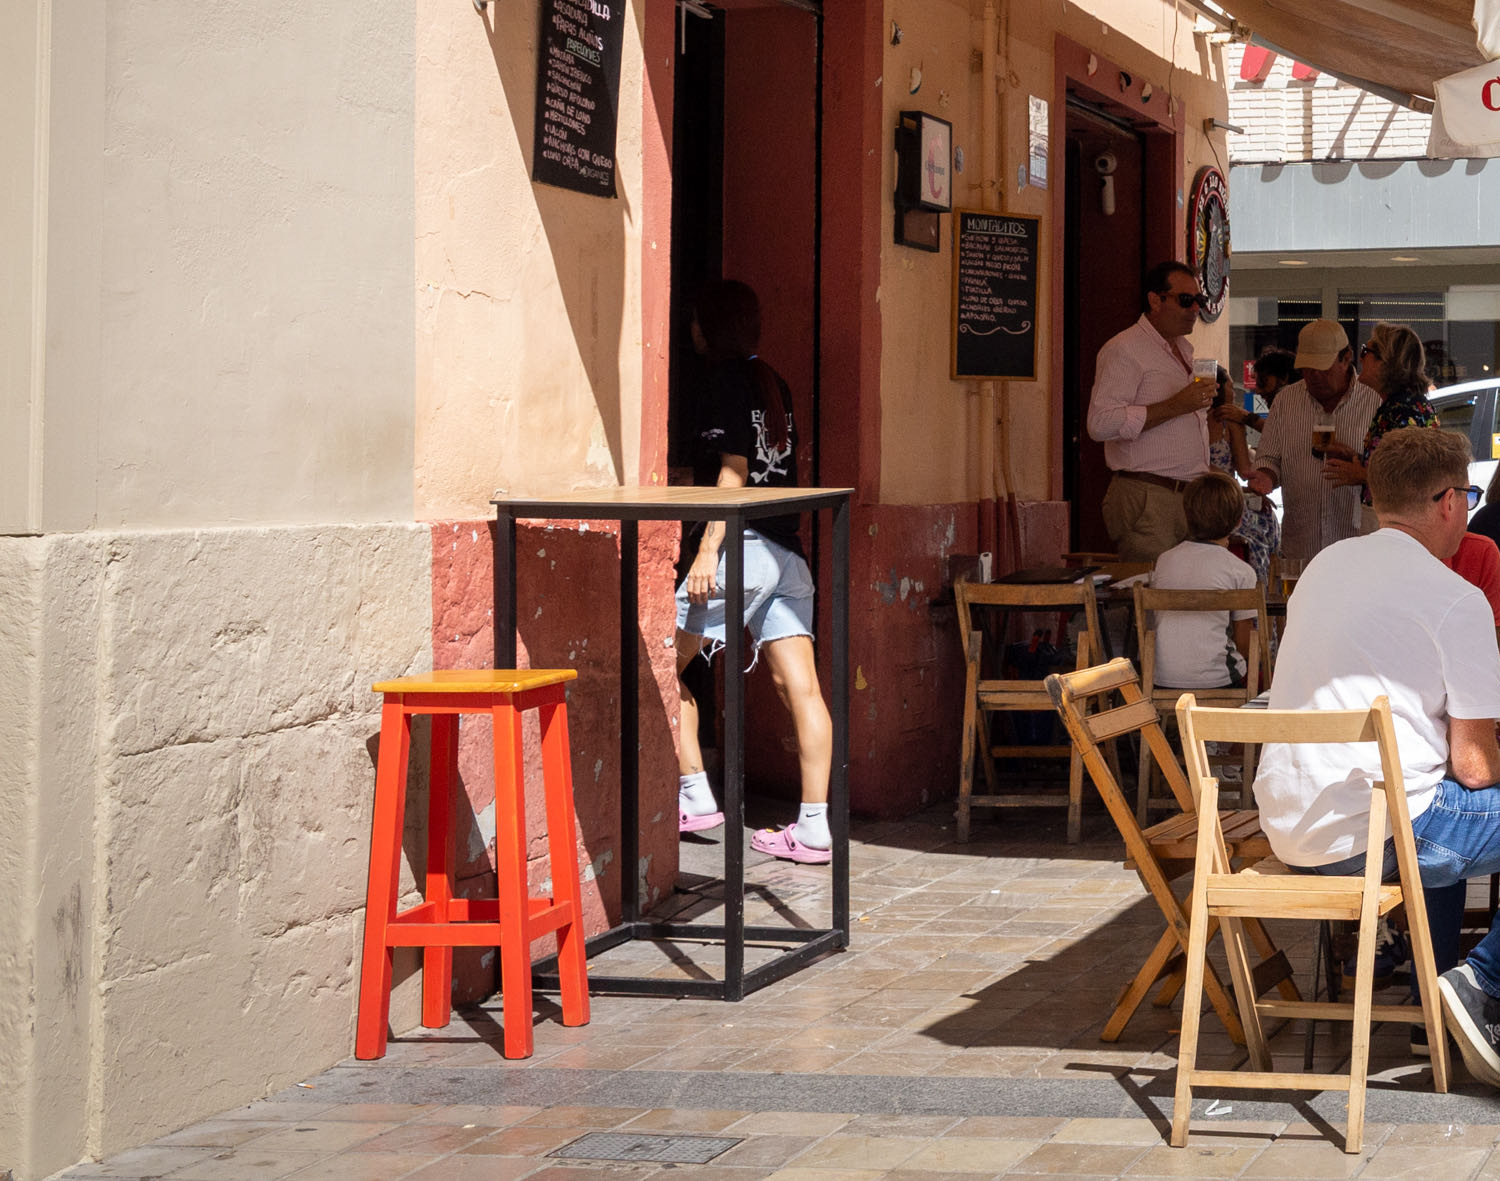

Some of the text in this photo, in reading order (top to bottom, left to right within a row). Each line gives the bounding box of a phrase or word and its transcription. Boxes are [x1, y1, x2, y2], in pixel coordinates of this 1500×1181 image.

[556, 14, 578, 36] PAPAS
[566, 37, 601, 64] PAPELONES
[549, 110, 587, 136] MEJILLONES
[575, 109, 592, 125] LOMO
[577, 147, 591, 161] CON
[591, 153, 613, 169] QUESO
[967, 217, 1027, 235] MONTADITOS
